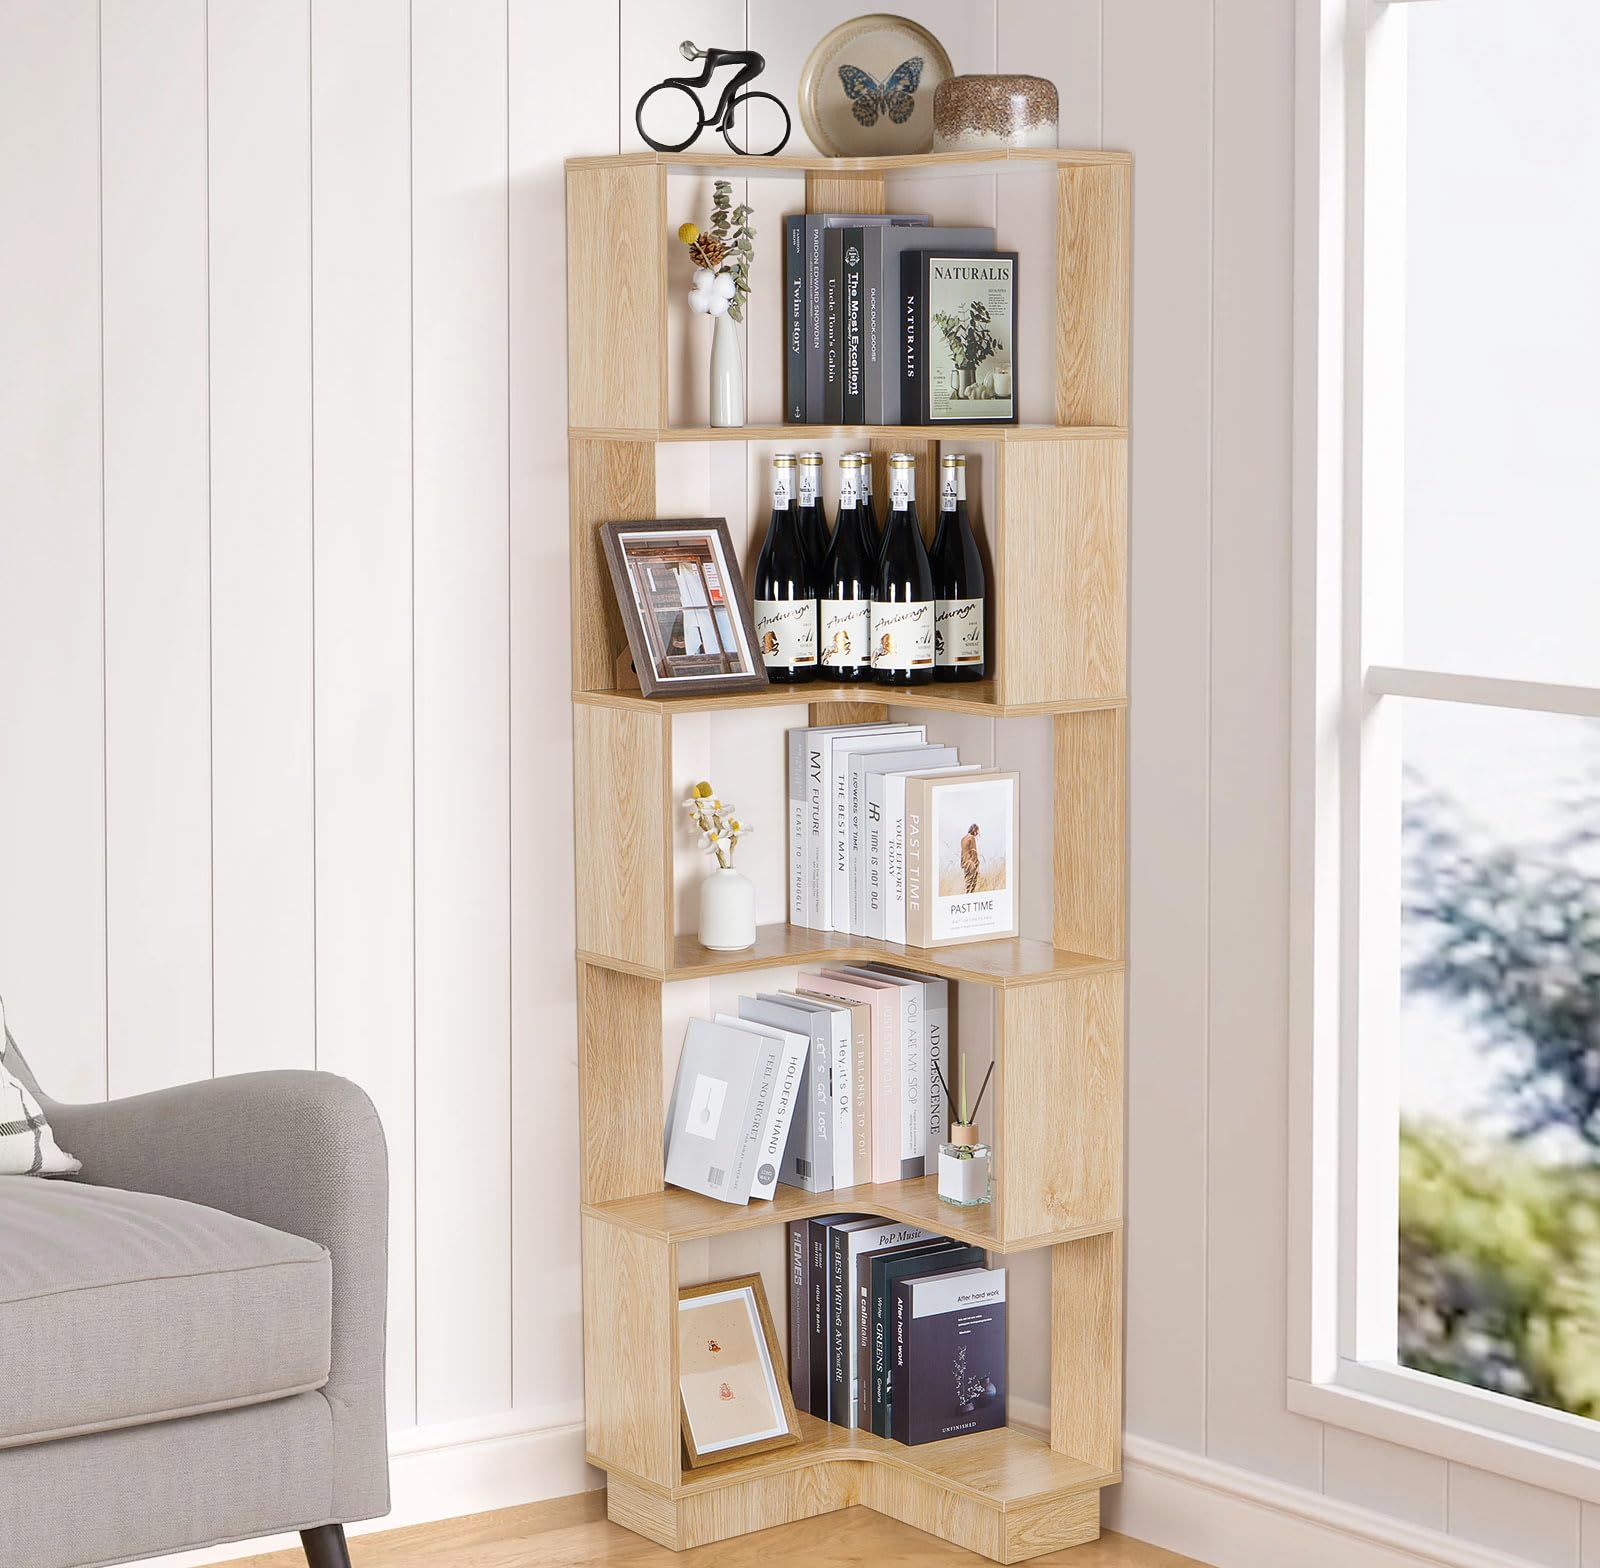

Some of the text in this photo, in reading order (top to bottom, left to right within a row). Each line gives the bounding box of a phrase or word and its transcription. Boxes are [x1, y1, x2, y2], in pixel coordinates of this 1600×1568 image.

[851, 272, 859, 297] The
[934, 267, 1009, 281] NATURALIS
[792, 277, 802, 354] Twins story
[828, 278, 837, 382] Uncle Tom's Cabin
[851, 300, 859, 332] Most
[907, 296, 915, 378] NATURALIS
[851, 335, 859, 395] Excellent
[810, 751, 822, 784] MY
[812, 788, 820, 837] FUTURE
[853, 816, 858, 829] OF
[796, 846, 802, 858] TO
[888, 839, 896, 878] TODAY
[895, 818, 903, 902] YOUR EFFORTS
[909, 814, 920, 912] PAST TIME
[950, 900, 994, 915] PAST TIME
[907, 997, 917, 1023] YOU
[857, 1033, 865, 1046] IT
[907, 1028, 918, 1049] ARE
[907, 1053, 919, 1073] MY
[929, 1023, 941, 1135] ADOLESCENCE
[748, 1053, 775, 1143] FEEL NO REGRET
[816, 1036, 828, 1142] LET'S GET LOST
[908, 1077, 920, 1105] STOP
[768, 1056, 798, 1155] HOLDER'S HAND
[857, 1111, 866, 1127] TO
[896, 1228, 922, 1243] Music
[793, 1231, 803, 1286] HOMES
[834, 1251, 842, 1282] BEST
[957, 1295, 971, 1303] After
[972, 1291, 986, 1300] hard
[986, 1289, 1000, 1297] work
[875, 1322, 884, 1373] GREENS
